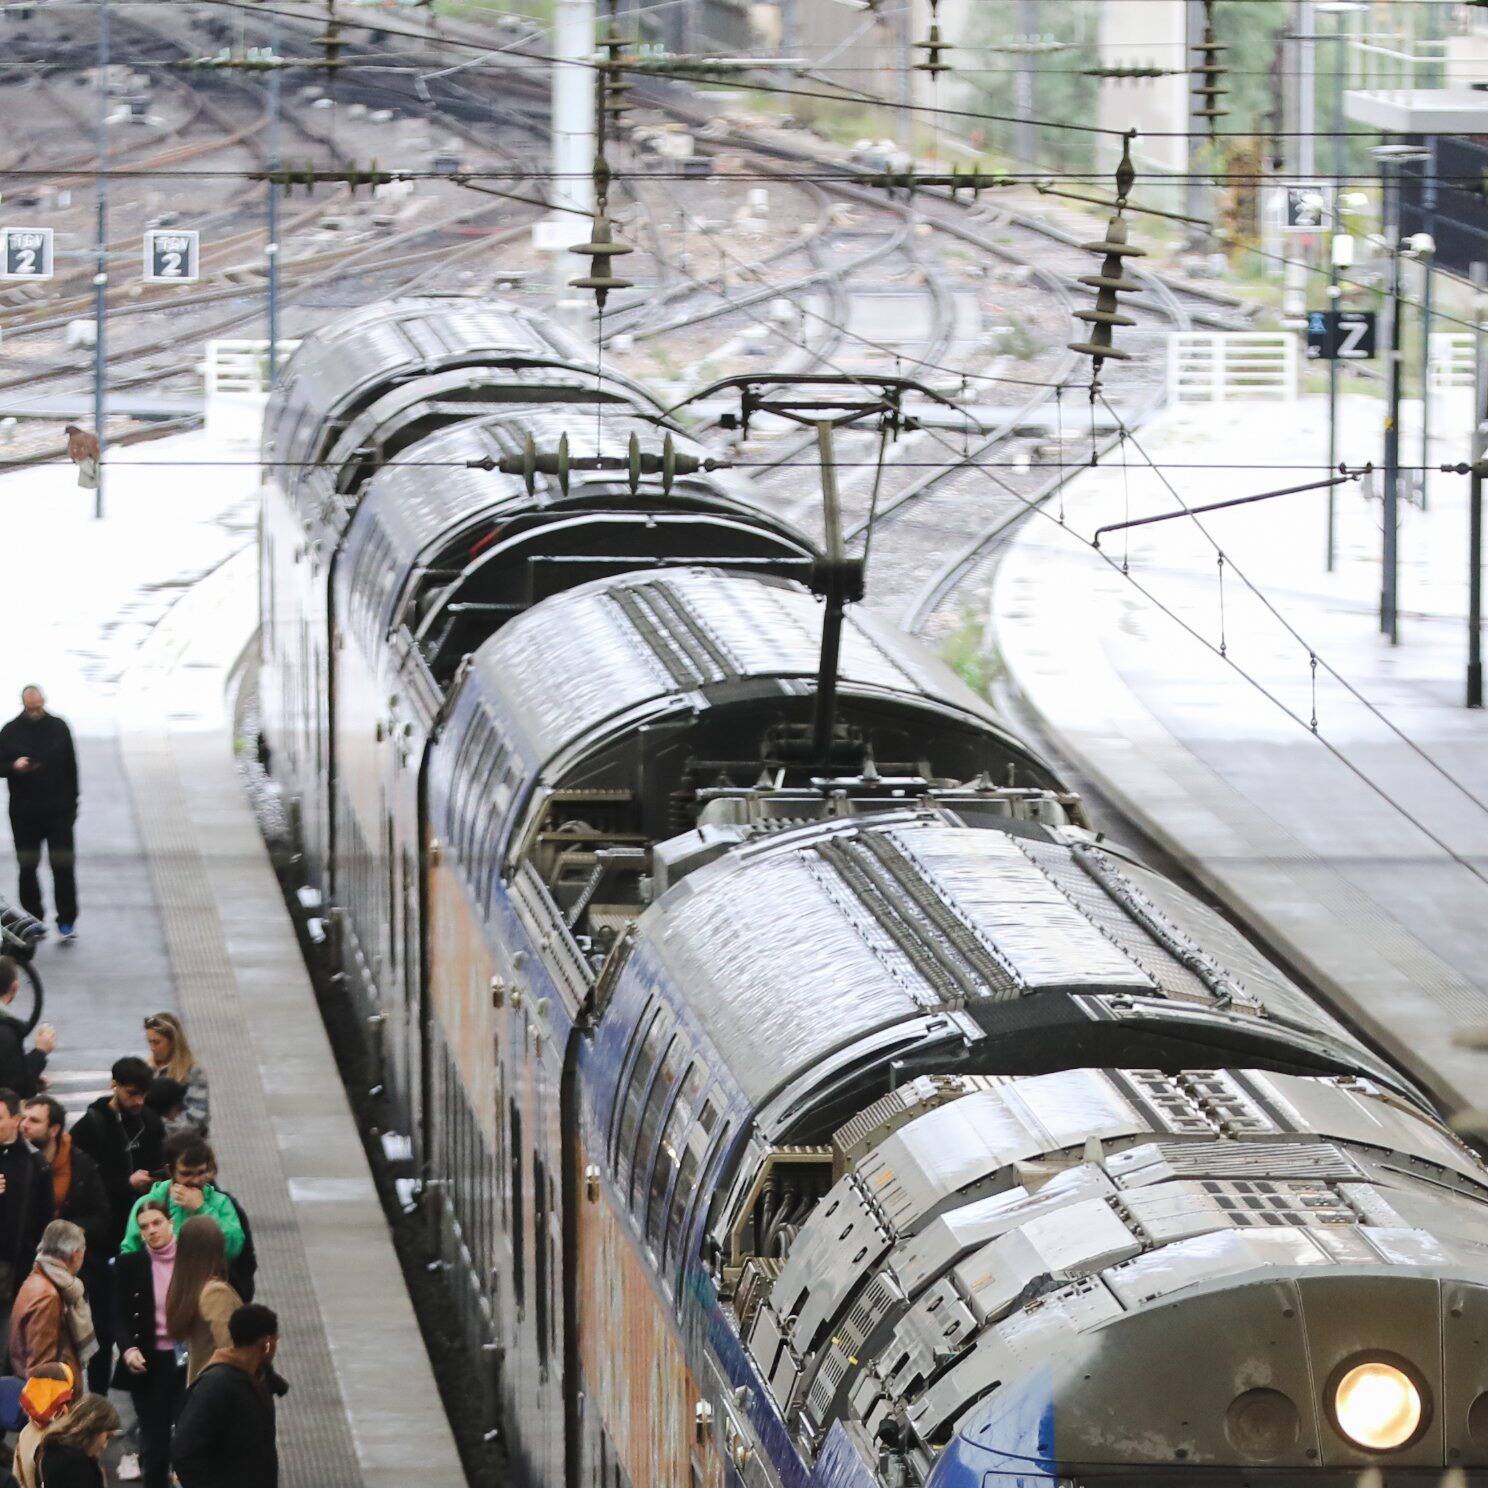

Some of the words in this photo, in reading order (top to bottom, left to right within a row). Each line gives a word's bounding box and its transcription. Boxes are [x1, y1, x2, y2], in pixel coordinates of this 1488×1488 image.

[14, 249, 36, 273] 2
[161, 252, 182, 276] 2
[1337, 321, 1369, 358] Z
